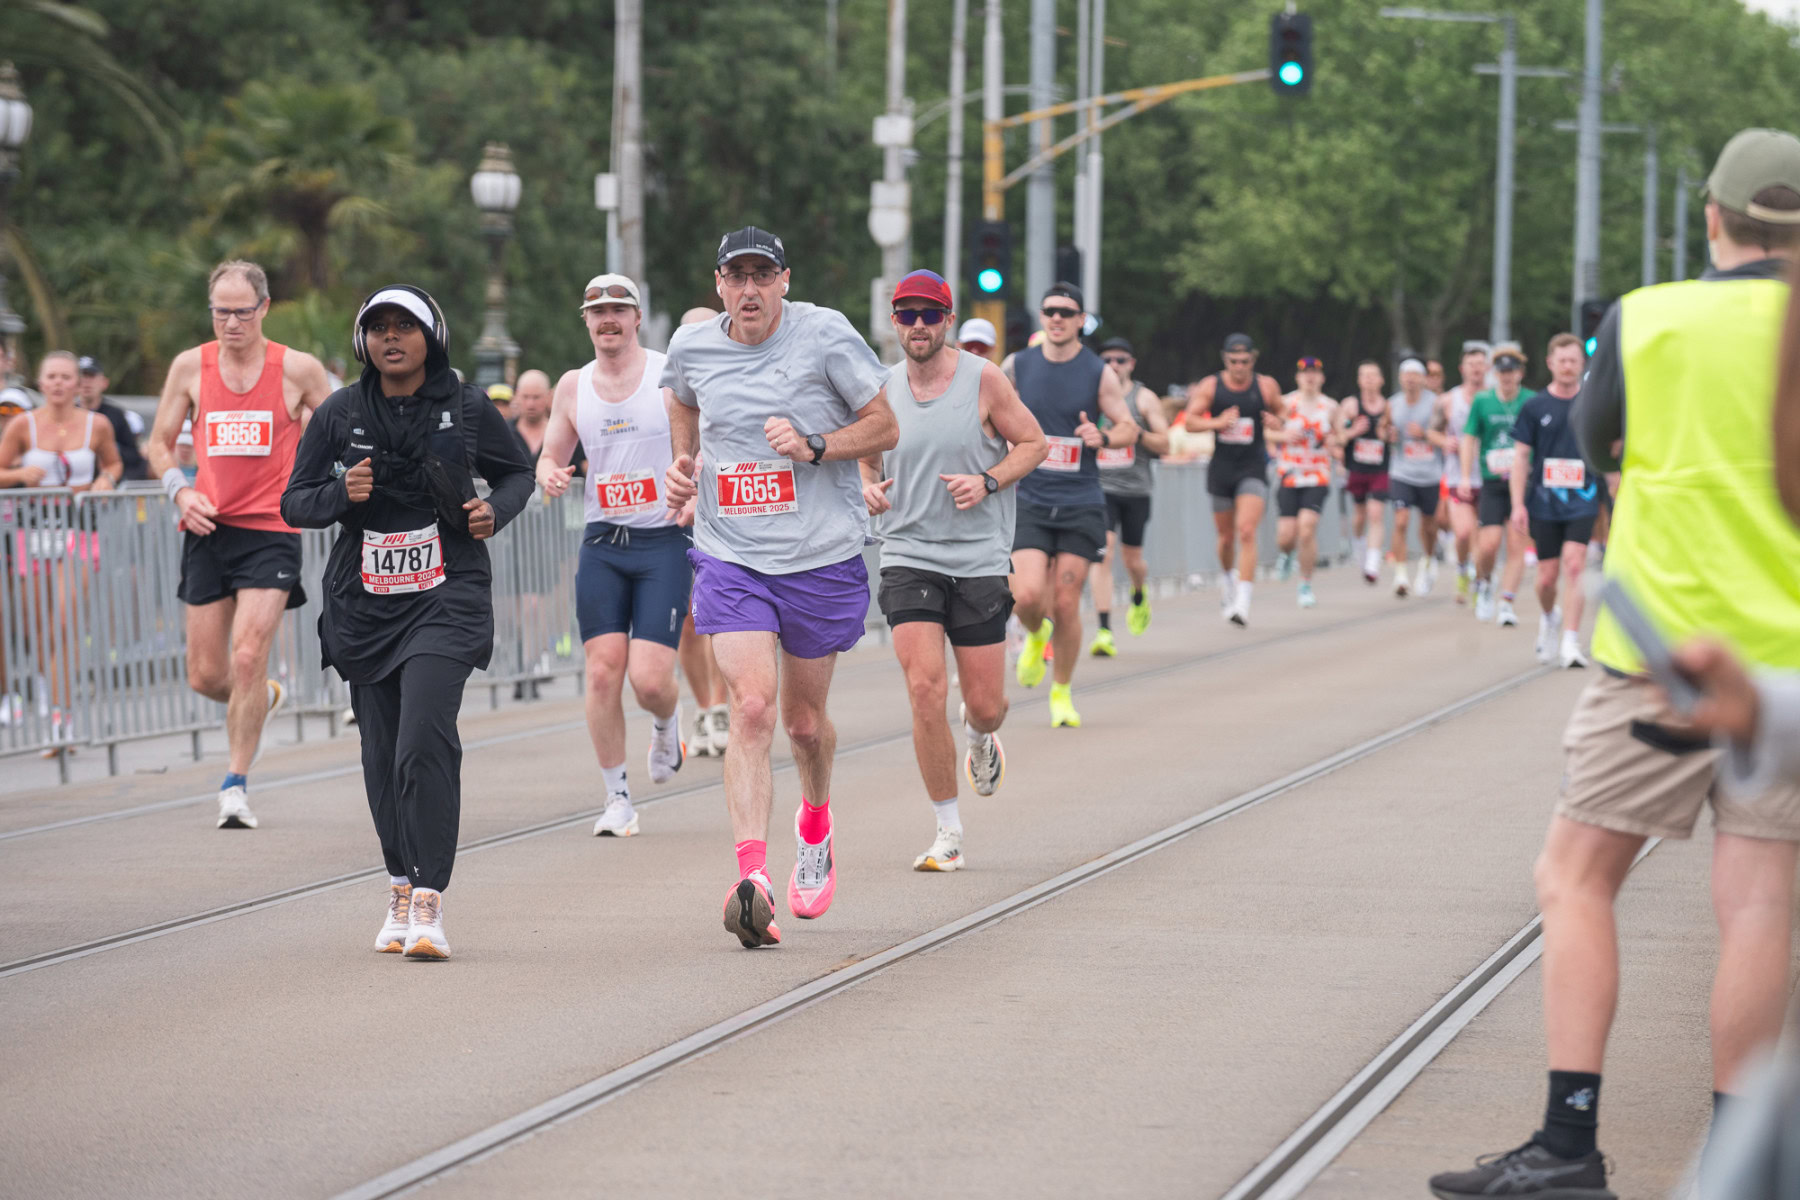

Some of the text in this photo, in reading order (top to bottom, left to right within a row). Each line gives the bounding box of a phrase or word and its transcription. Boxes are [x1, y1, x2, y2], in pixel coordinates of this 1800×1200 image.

[217, 422, 261, 445] 9658
[605, 481, 647, 507] 6212
[728, 474, 781, 504] 7655
[724, 503, 790, 515] MELBOURNE 2025
[371, 542, 433, 574] 14787
[368, 569, 437, 585] MELBOURNE 2025
